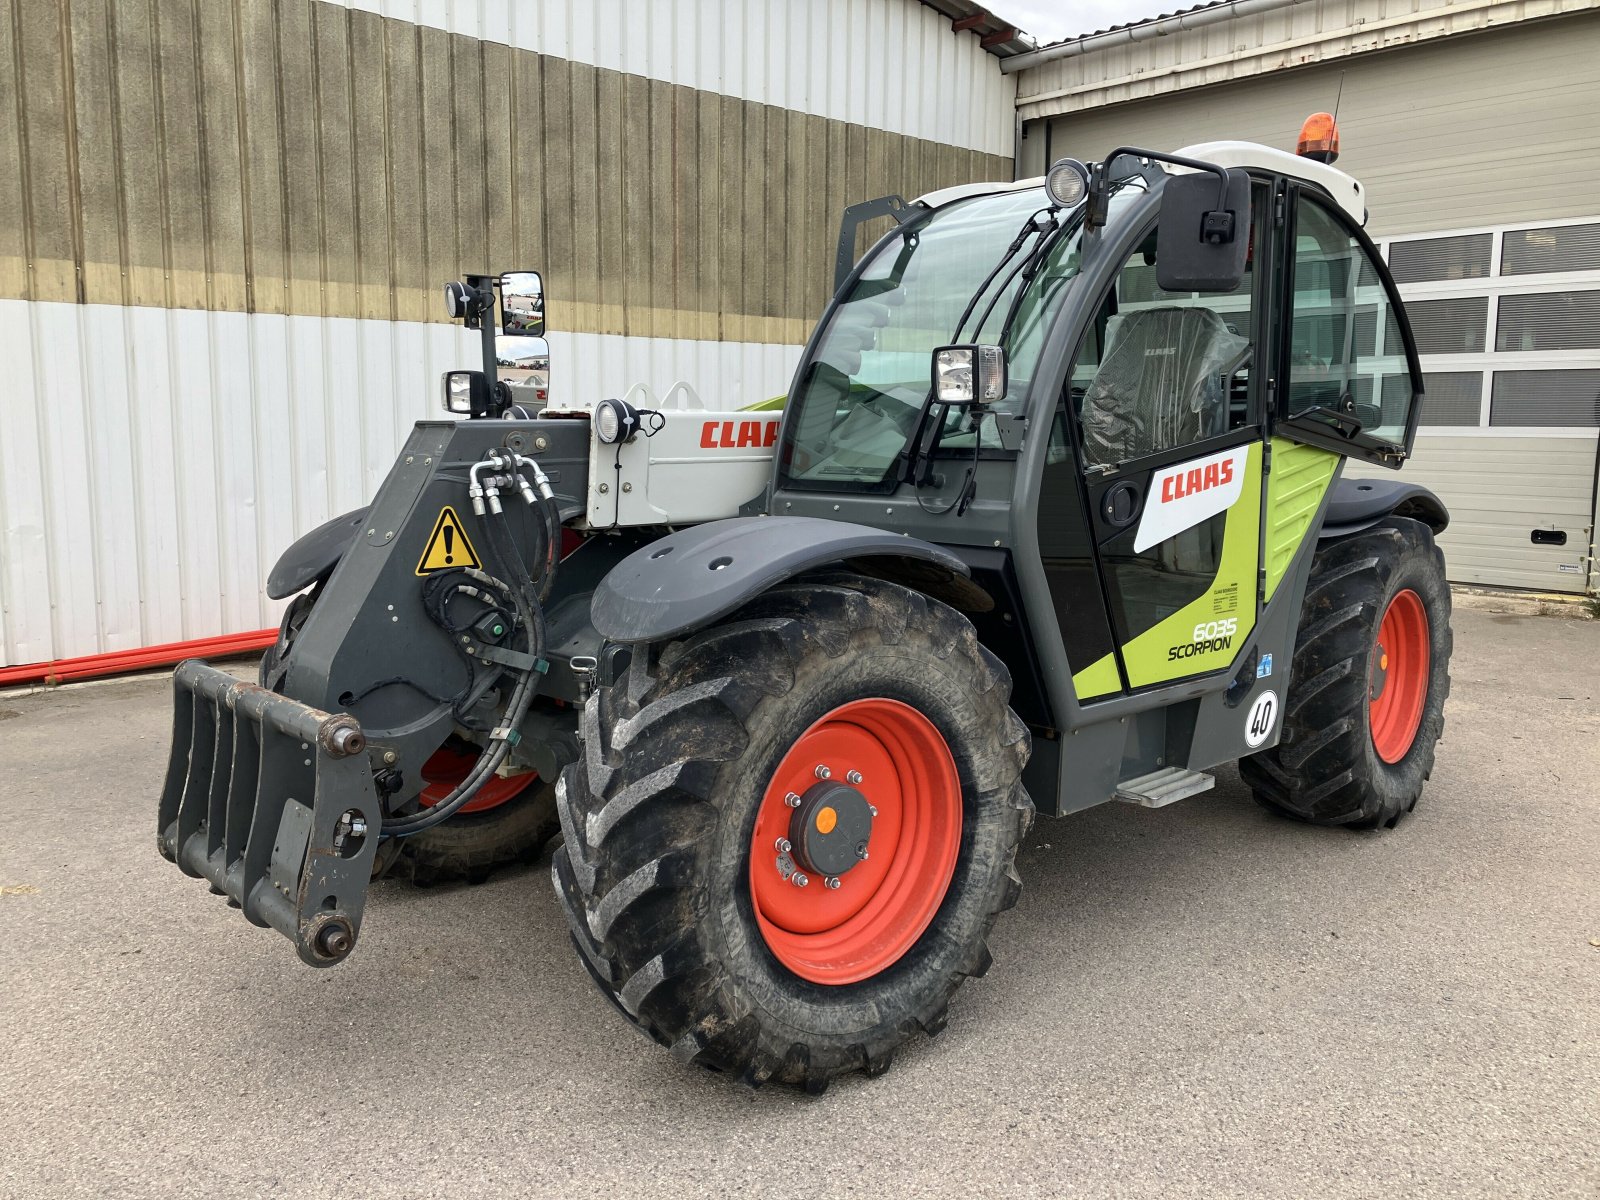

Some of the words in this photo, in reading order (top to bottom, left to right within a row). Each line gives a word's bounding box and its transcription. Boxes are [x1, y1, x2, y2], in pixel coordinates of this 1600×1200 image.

[1161, 458, 1233, 504] CLAAS
[1193, 617, 1238, 642] 6035
[1167, 636, 1232, 661] SCORPION
[1250, 700, 1272, 738] 40
